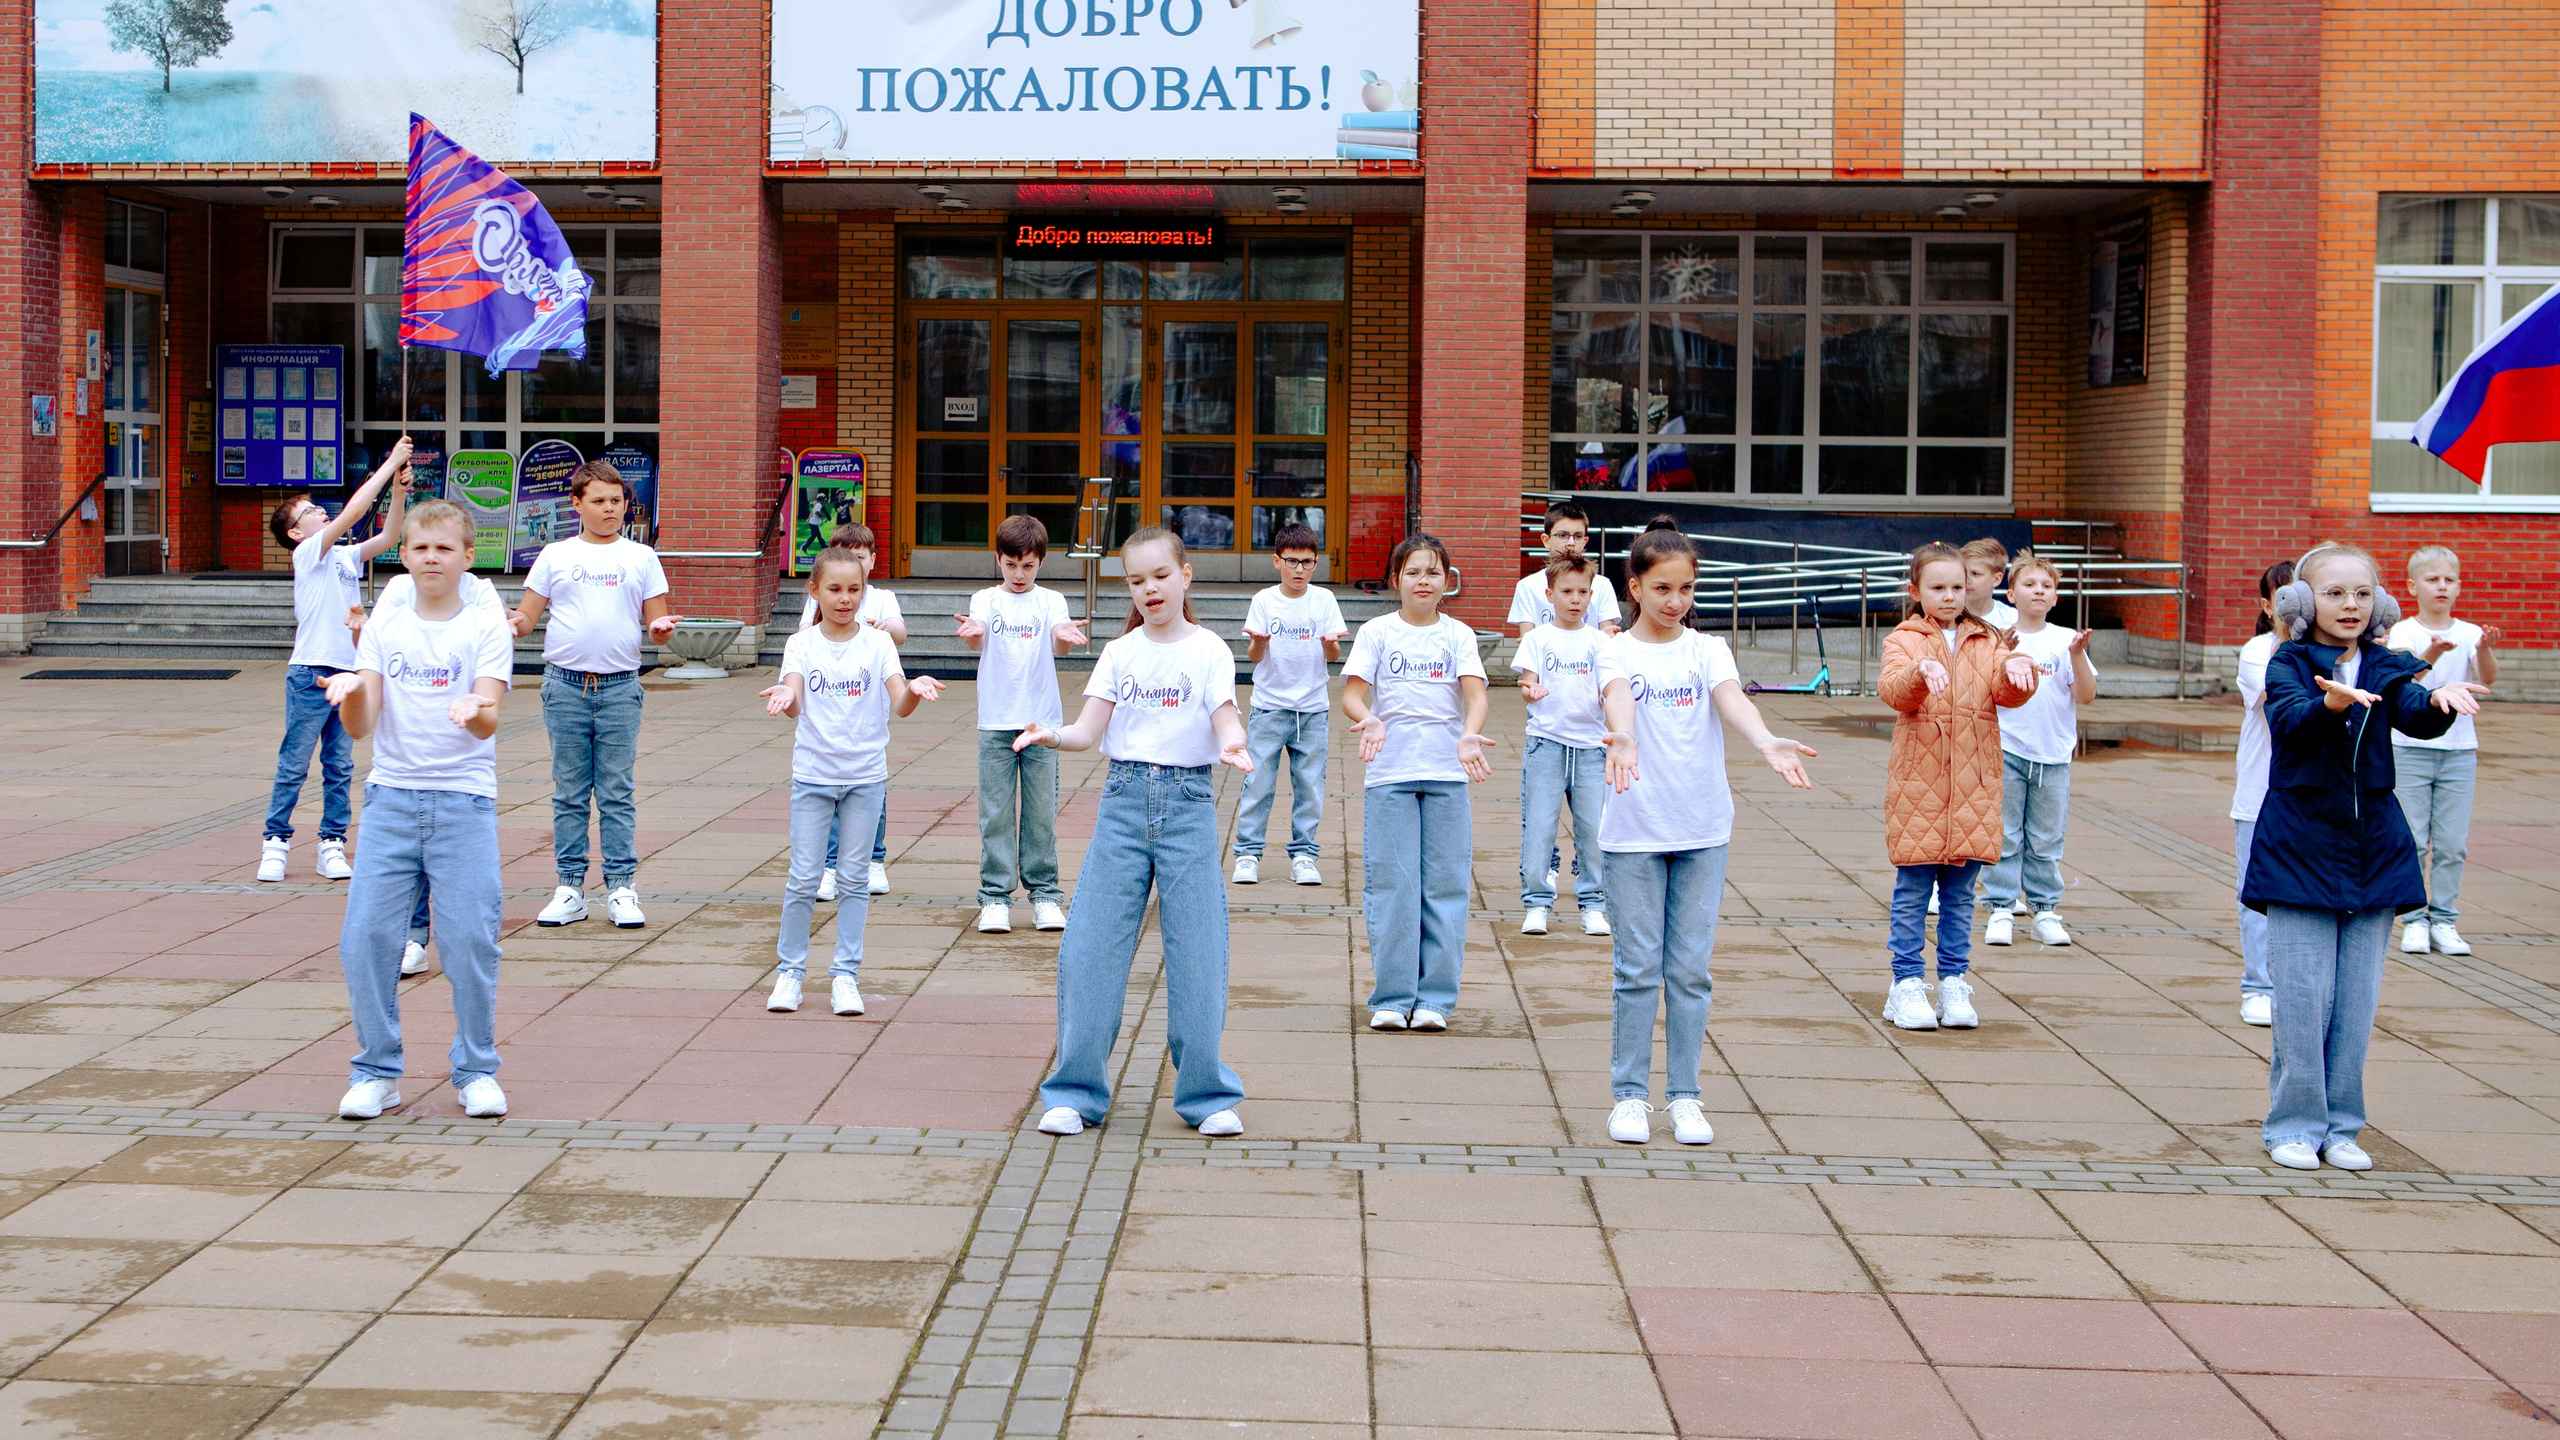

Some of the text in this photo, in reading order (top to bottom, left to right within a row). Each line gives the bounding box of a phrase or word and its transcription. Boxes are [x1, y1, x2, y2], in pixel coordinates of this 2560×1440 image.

[987, 0, 1204, 49] ДОБРО
[856, 65, 1332, 113] ПОЖАЛОВАТЬ!
[1016, 226, 1213, 248] Добро пожаловать!
[241, 355, 319, 364] ИНФОРМАЦИЯ
[948, 403, 975, 411] ВХОД
[525, 461, 576, 473] Клуб аэробики
[804, 463, 860, 474] ЛАЗЕРТАГА
[558, 485, 563, 493] 5
[572, 564, 618, 583] Орлята
[992, 613, 1033, 635] Орлята
[1270, 616, 1310, 637] Орлята
[387, 651, 449, 682] Орлята
[1389, 650, 1444, 676] Орлята
[1545, 651, 1588, 673] Орлята
[809, 669, 861, 695] Орлята
[1121, 674, 1180, 704] Орлята
[1630, 673, 1693, 705] Орлята
